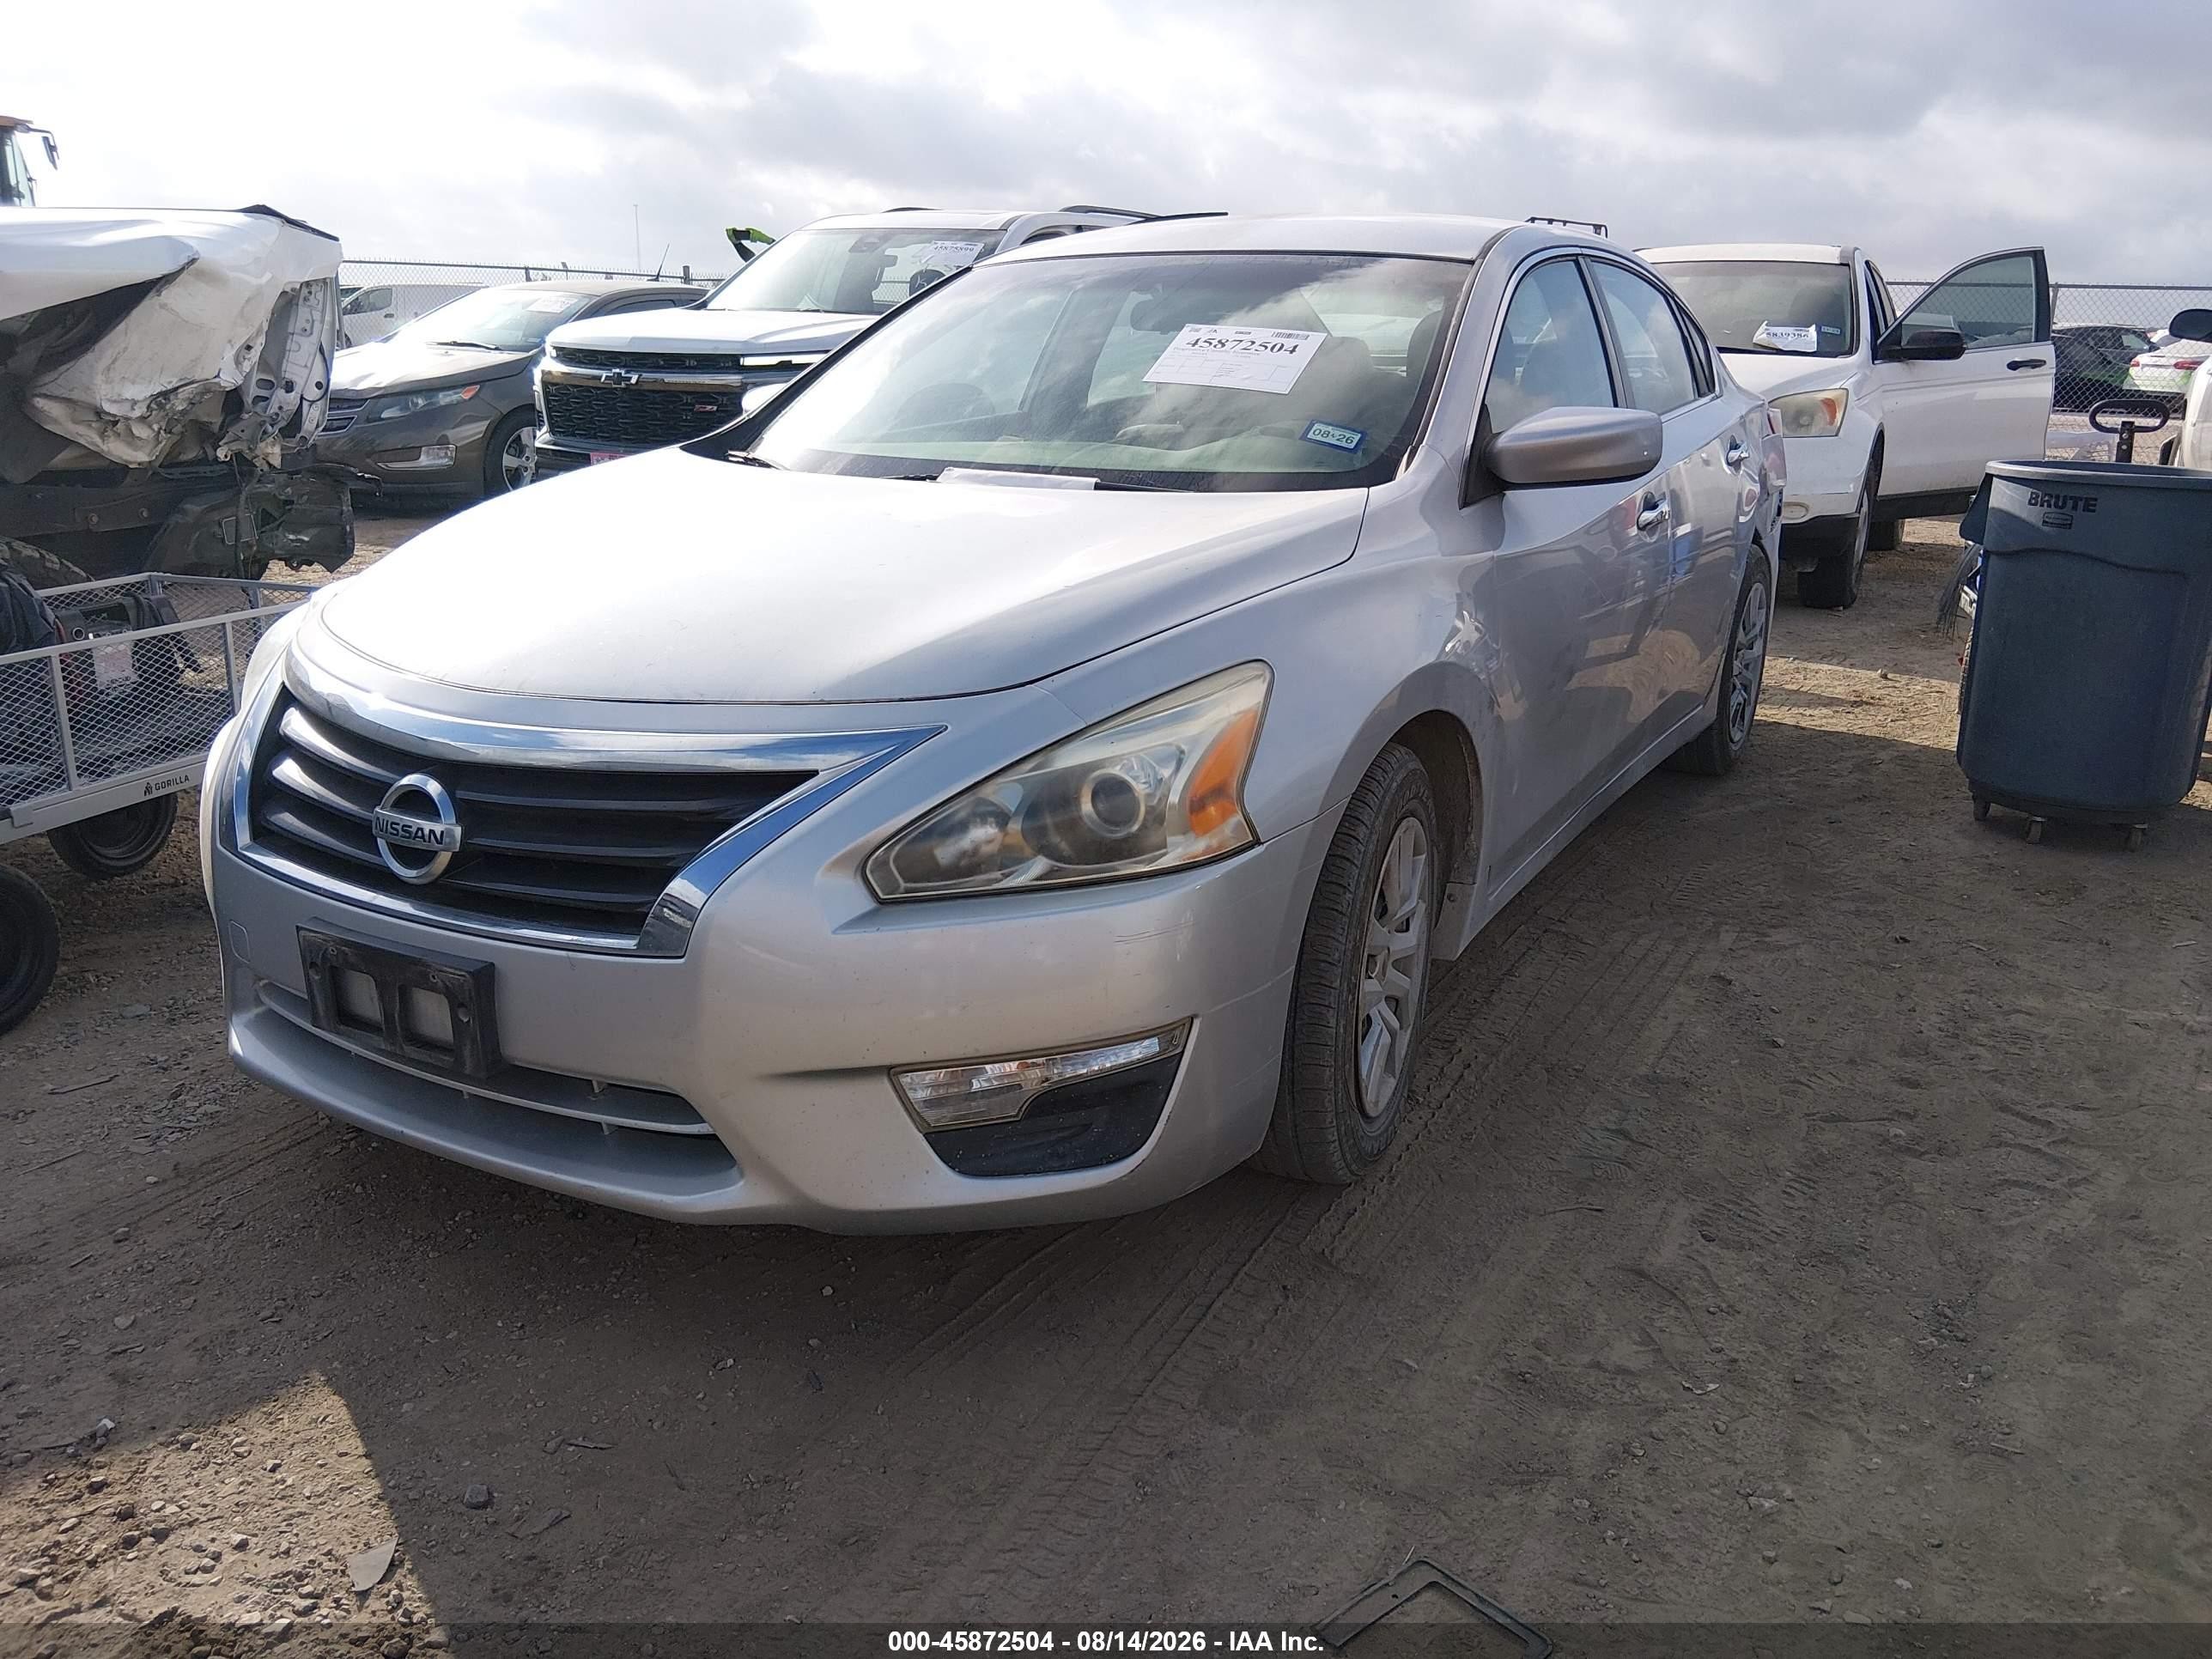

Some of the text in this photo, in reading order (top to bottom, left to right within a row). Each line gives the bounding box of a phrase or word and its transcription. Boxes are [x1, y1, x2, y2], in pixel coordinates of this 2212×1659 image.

[1186, 337, 1298, 355] 45872504
[1312, 428, 1331, 439] 08
[1335, 434, 1356, 445] 26
[2027, 491, 2098, 513] BRUTE
[155, 775, 190, 791] GORILLA
[374, 817, 445, 846] NISSAN
